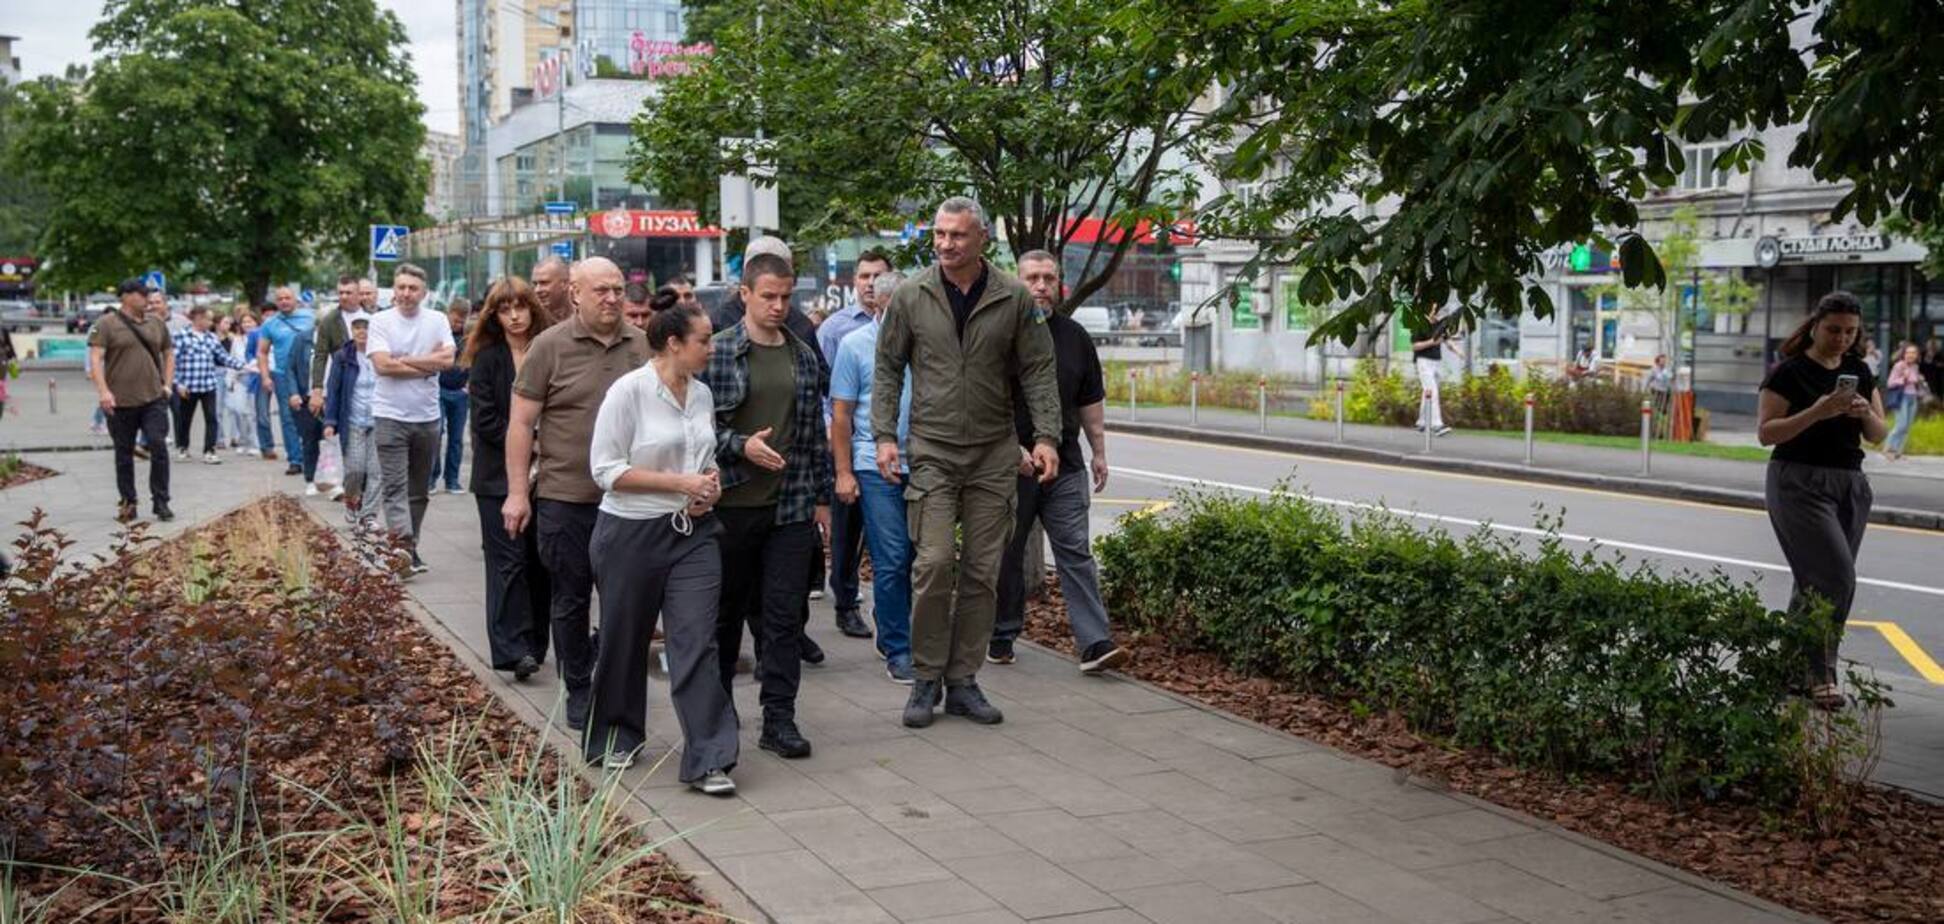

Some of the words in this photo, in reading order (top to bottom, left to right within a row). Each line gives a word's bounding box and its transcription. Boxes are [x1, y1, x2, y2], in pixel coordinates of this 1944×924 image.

[639, 214, 717, 232] ПУЗАТ
[1830, 235, 1883, 250] ЛОНДА
[827, 284, 858, 309] SM
